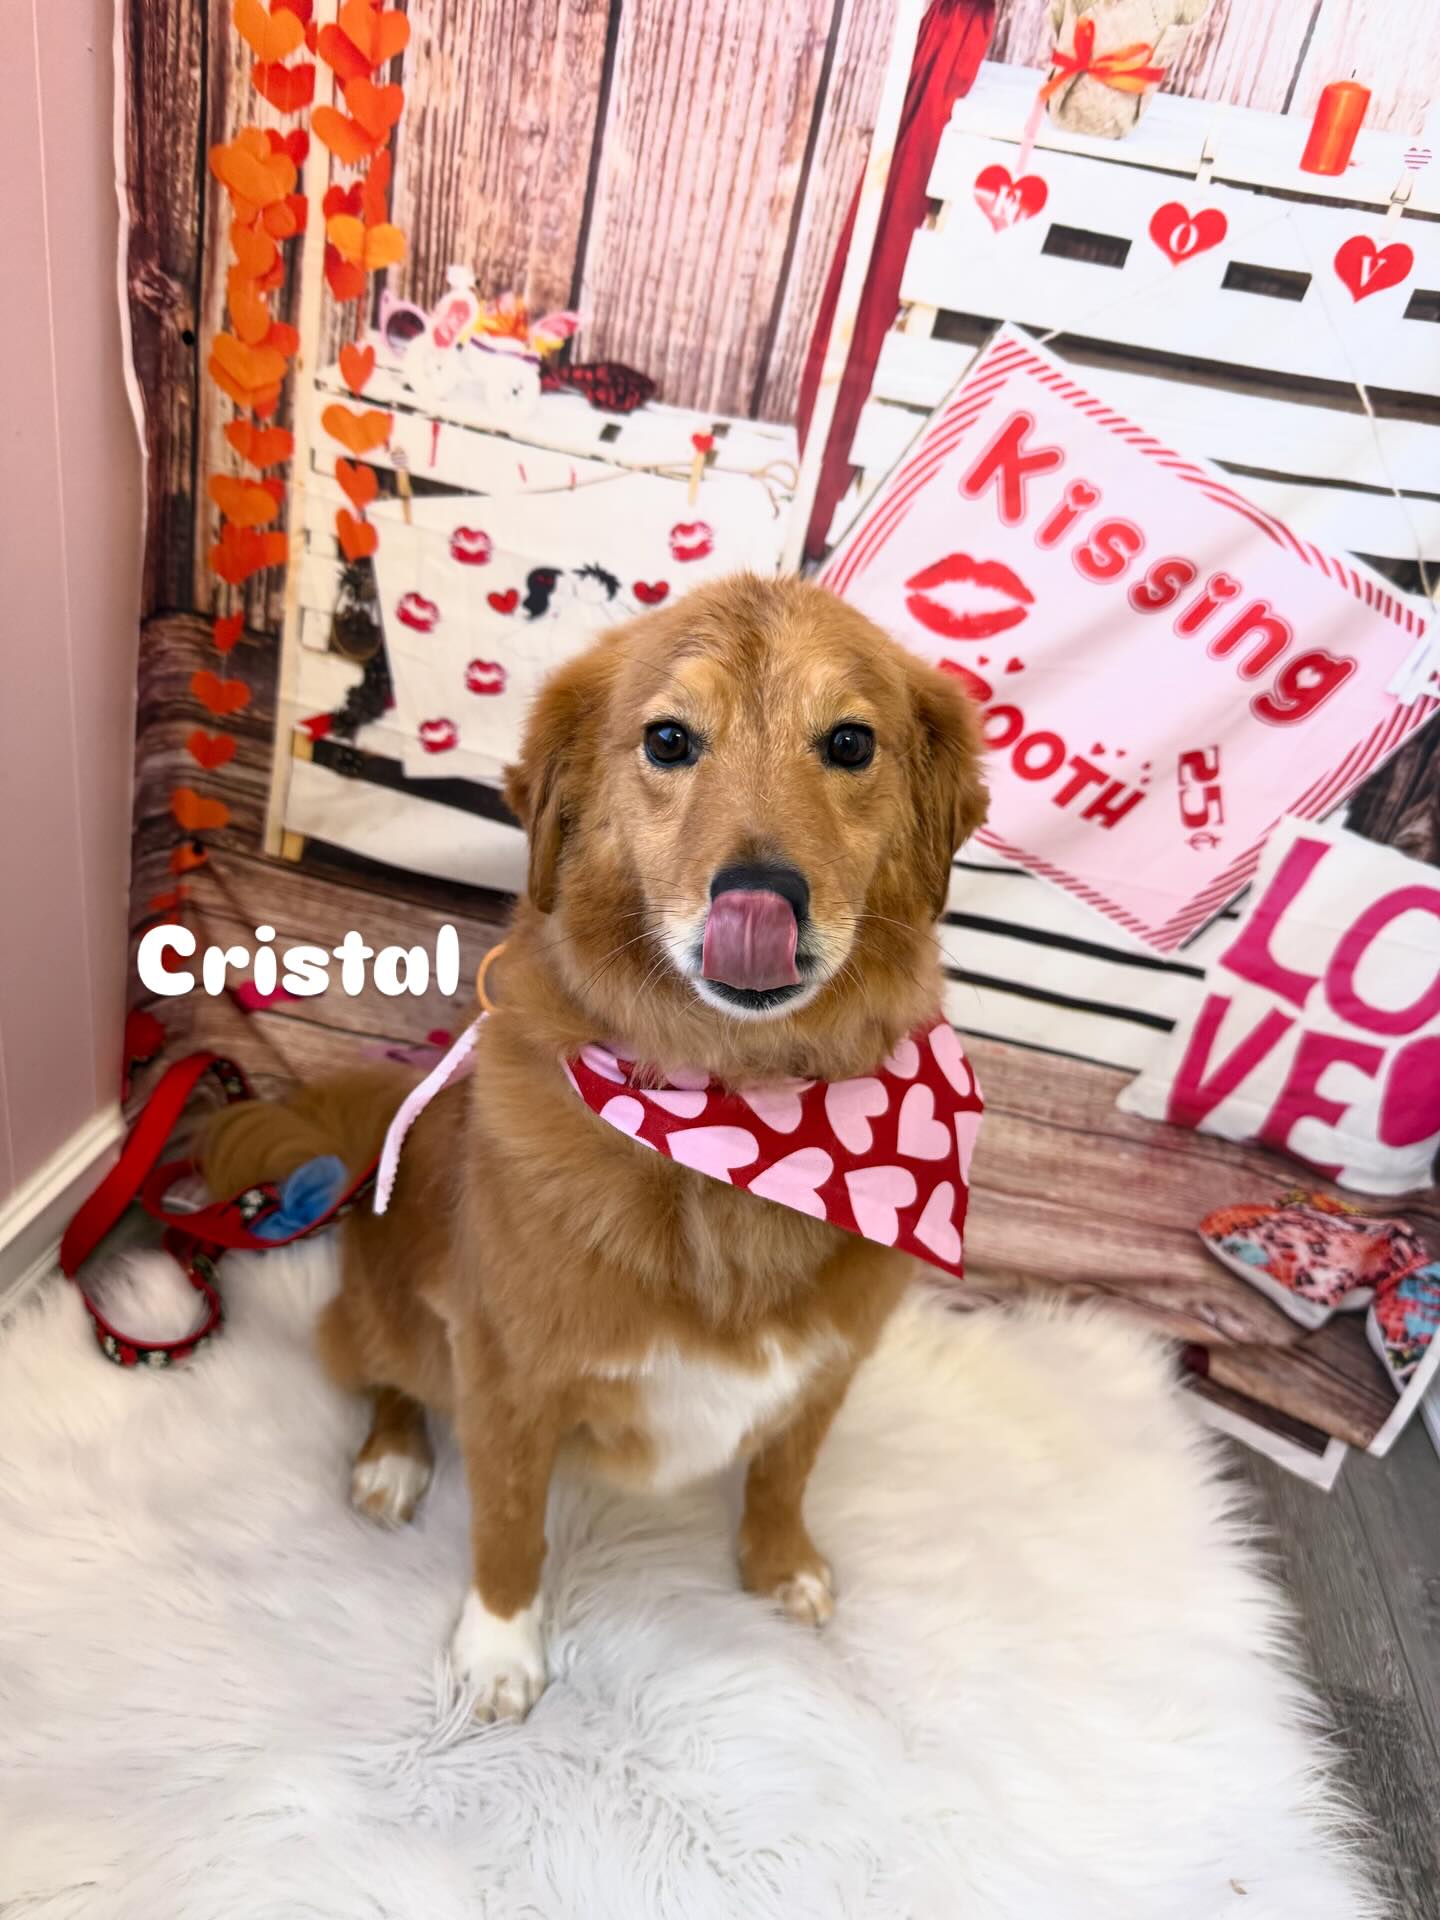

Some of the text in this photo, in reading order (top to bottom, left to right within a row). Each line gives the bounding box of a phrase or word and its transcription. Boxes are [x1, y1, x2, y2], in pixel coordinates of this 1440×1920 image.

[1169, 222, 1199, 255] O
[1361, 255, 1388, 288] V
[958, 410, 1359, 727] Kissing
